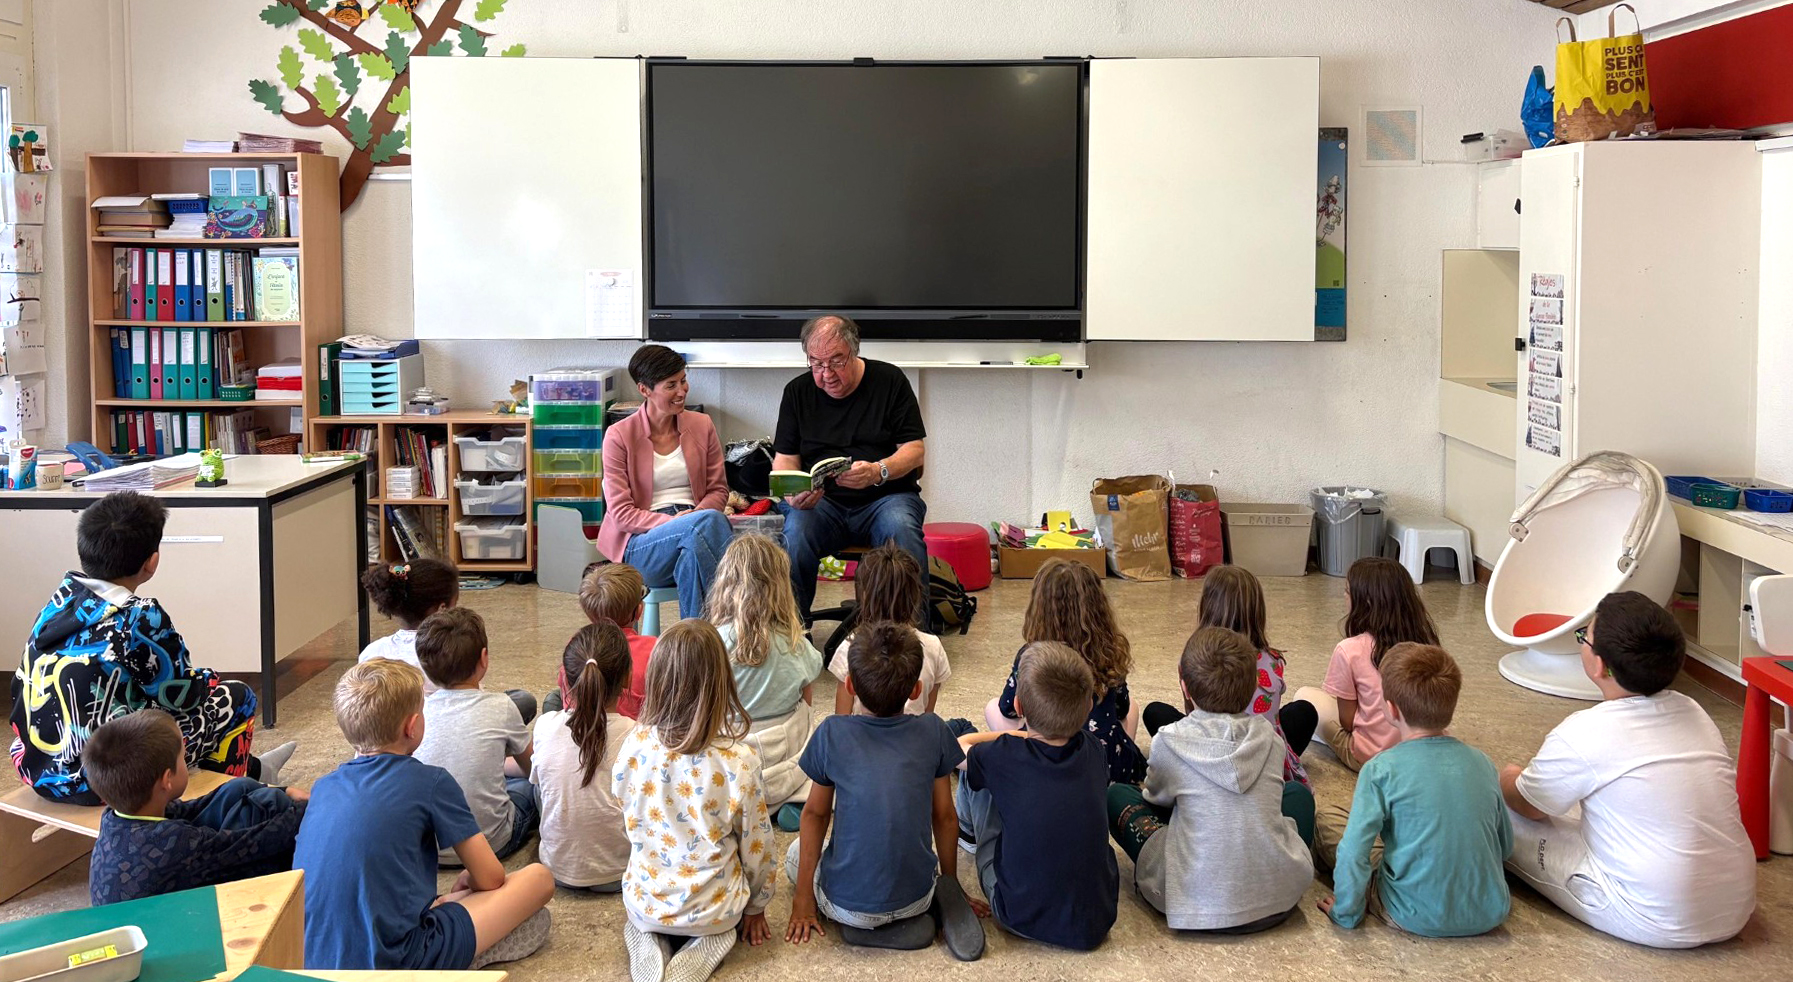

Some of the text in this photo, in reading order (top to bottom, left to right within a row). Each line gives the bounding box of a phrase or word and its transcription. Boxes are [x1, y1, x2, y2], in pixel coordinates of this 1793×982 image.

[1605, 46, 1633, 56] PLUS
[1605, 53, 1644, 71] SENT
[1606, 71, 1627, 79] PLUS
[1606, 77, 1645, 95] BON
[1249, 516, 1291, 525] PAPIER
